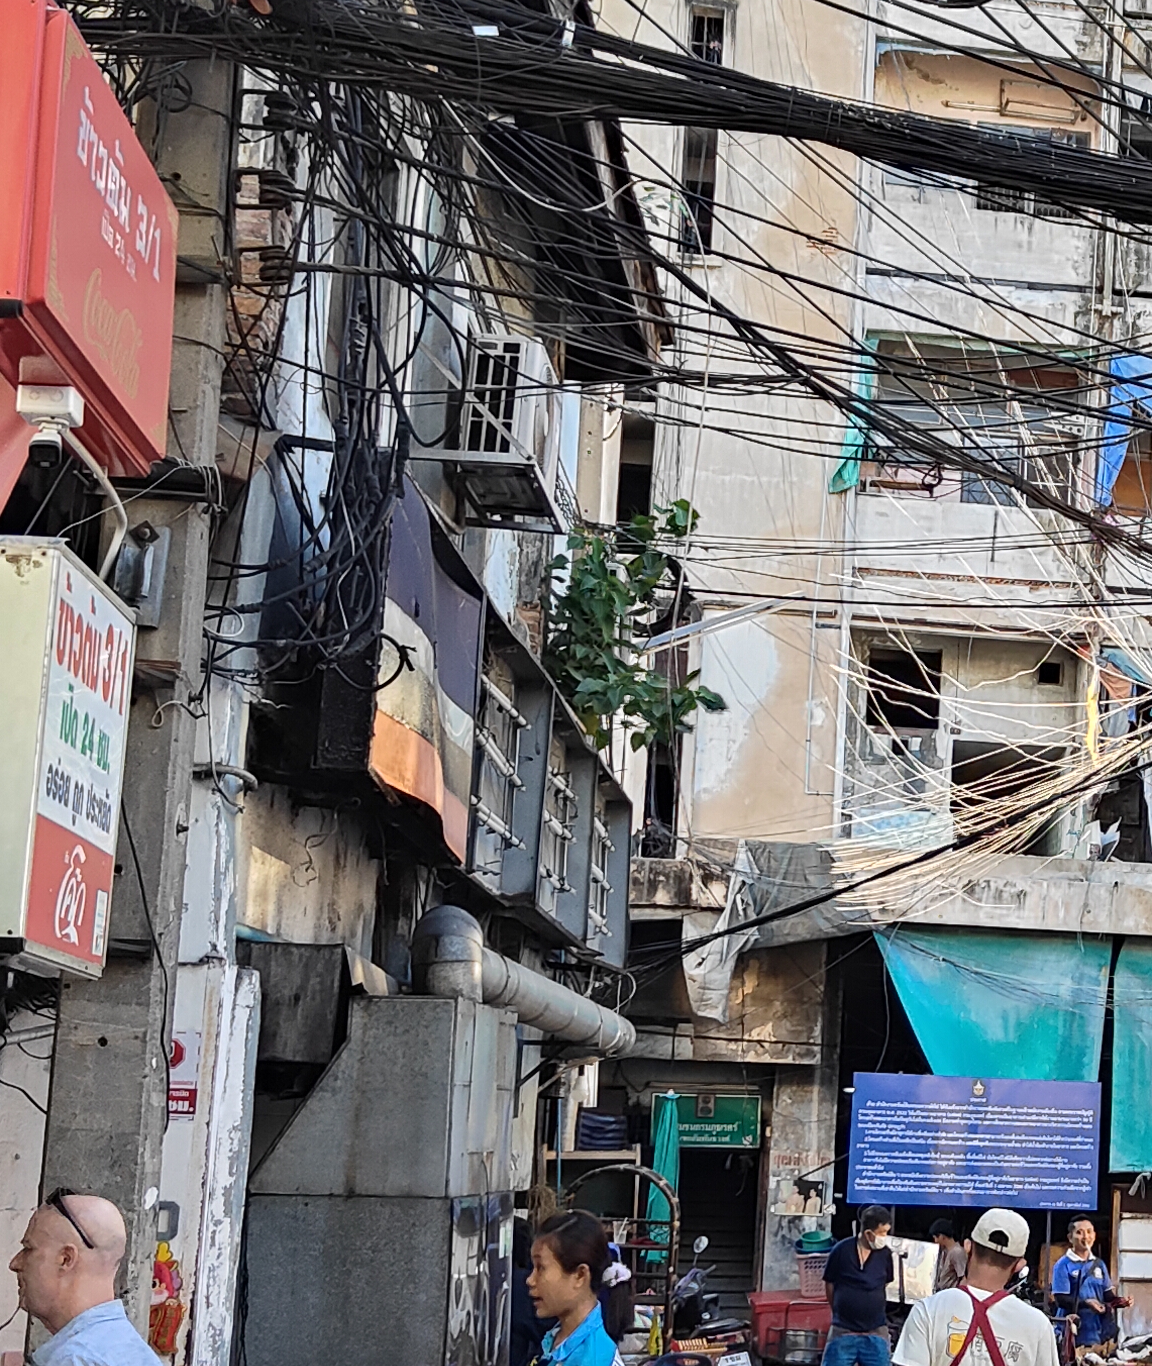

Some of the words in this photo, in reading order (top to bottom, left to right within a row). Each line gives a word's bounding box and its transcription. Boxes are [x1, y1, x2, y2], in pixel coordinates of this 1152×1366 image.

[77, 85, 132, 233] ข้าวต้ม
[56, 571, 102, 694] ข้าวต้ม
[102, 622, 129, 716] 3/1
[59, 681, 79, 750] เปิด
[80, 711, 96, 762] 24
[46, 757, 71, 808] อร่อย
[71, 780, 84, 828] ถูก
[85, 782, 113, 835] ประหยัด
